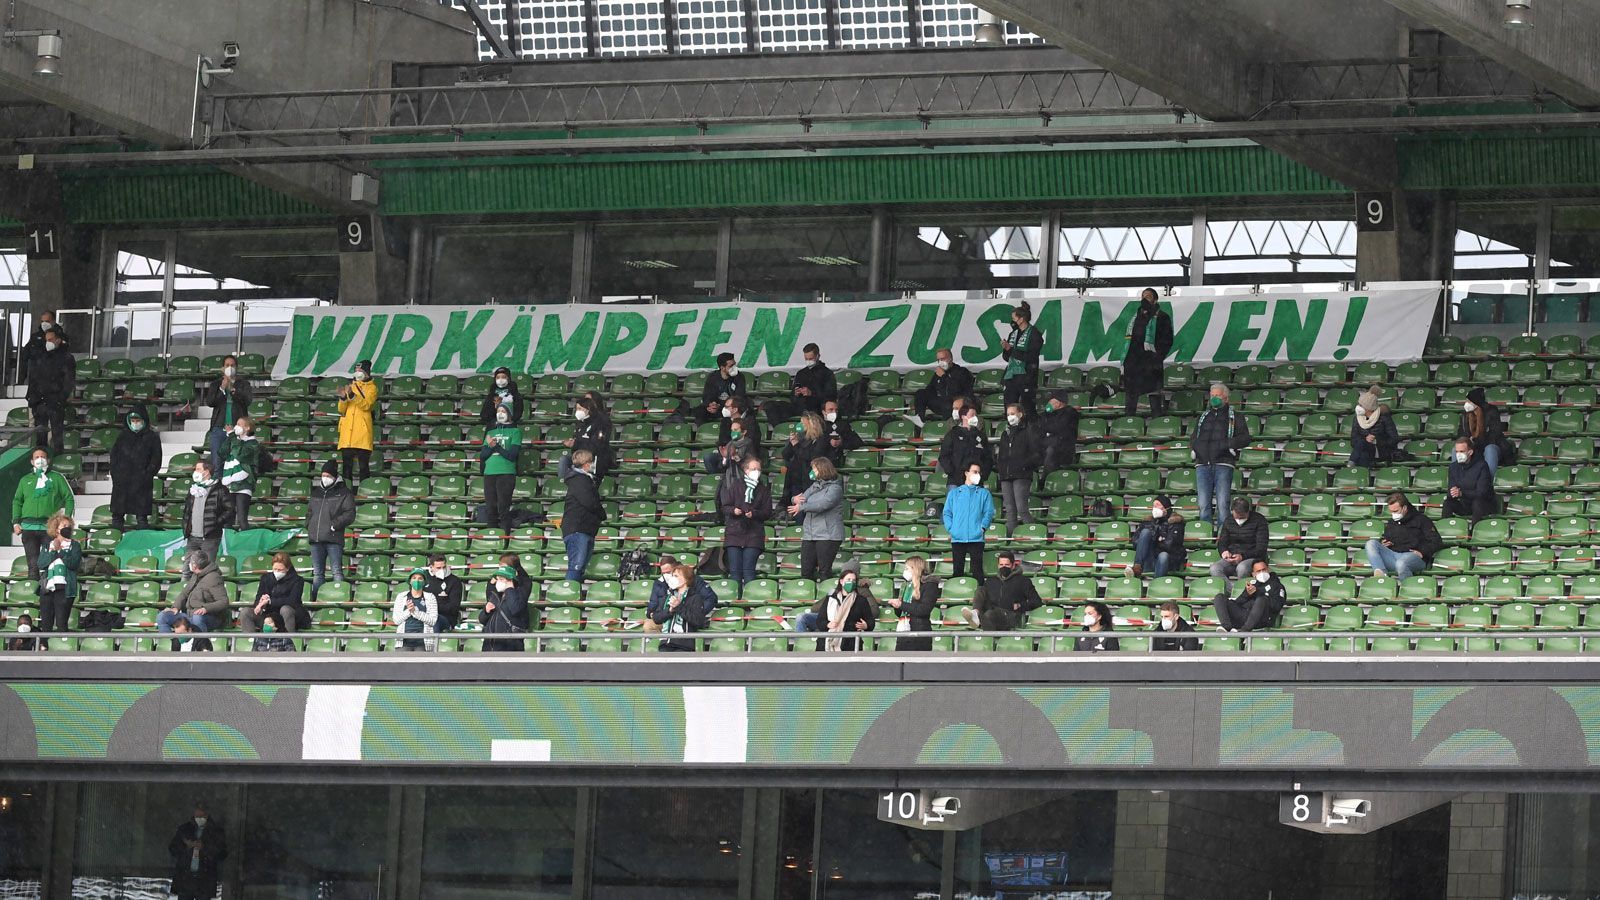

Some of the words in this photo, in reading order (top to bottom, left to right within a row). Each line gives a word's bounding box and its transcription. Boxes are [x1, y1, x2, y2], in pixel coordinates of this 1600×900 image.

[1367, 199, 1383, 224] 9
[30, 230, 54, 253] 11
[347, 221, 362, 246] 9
[286, 313, 433, 375] WIR
[430, 305, 806, 375] KÄMPFEN
[882, 791, 916, 819] 10
[1292, 794, 1310, 822] 8
